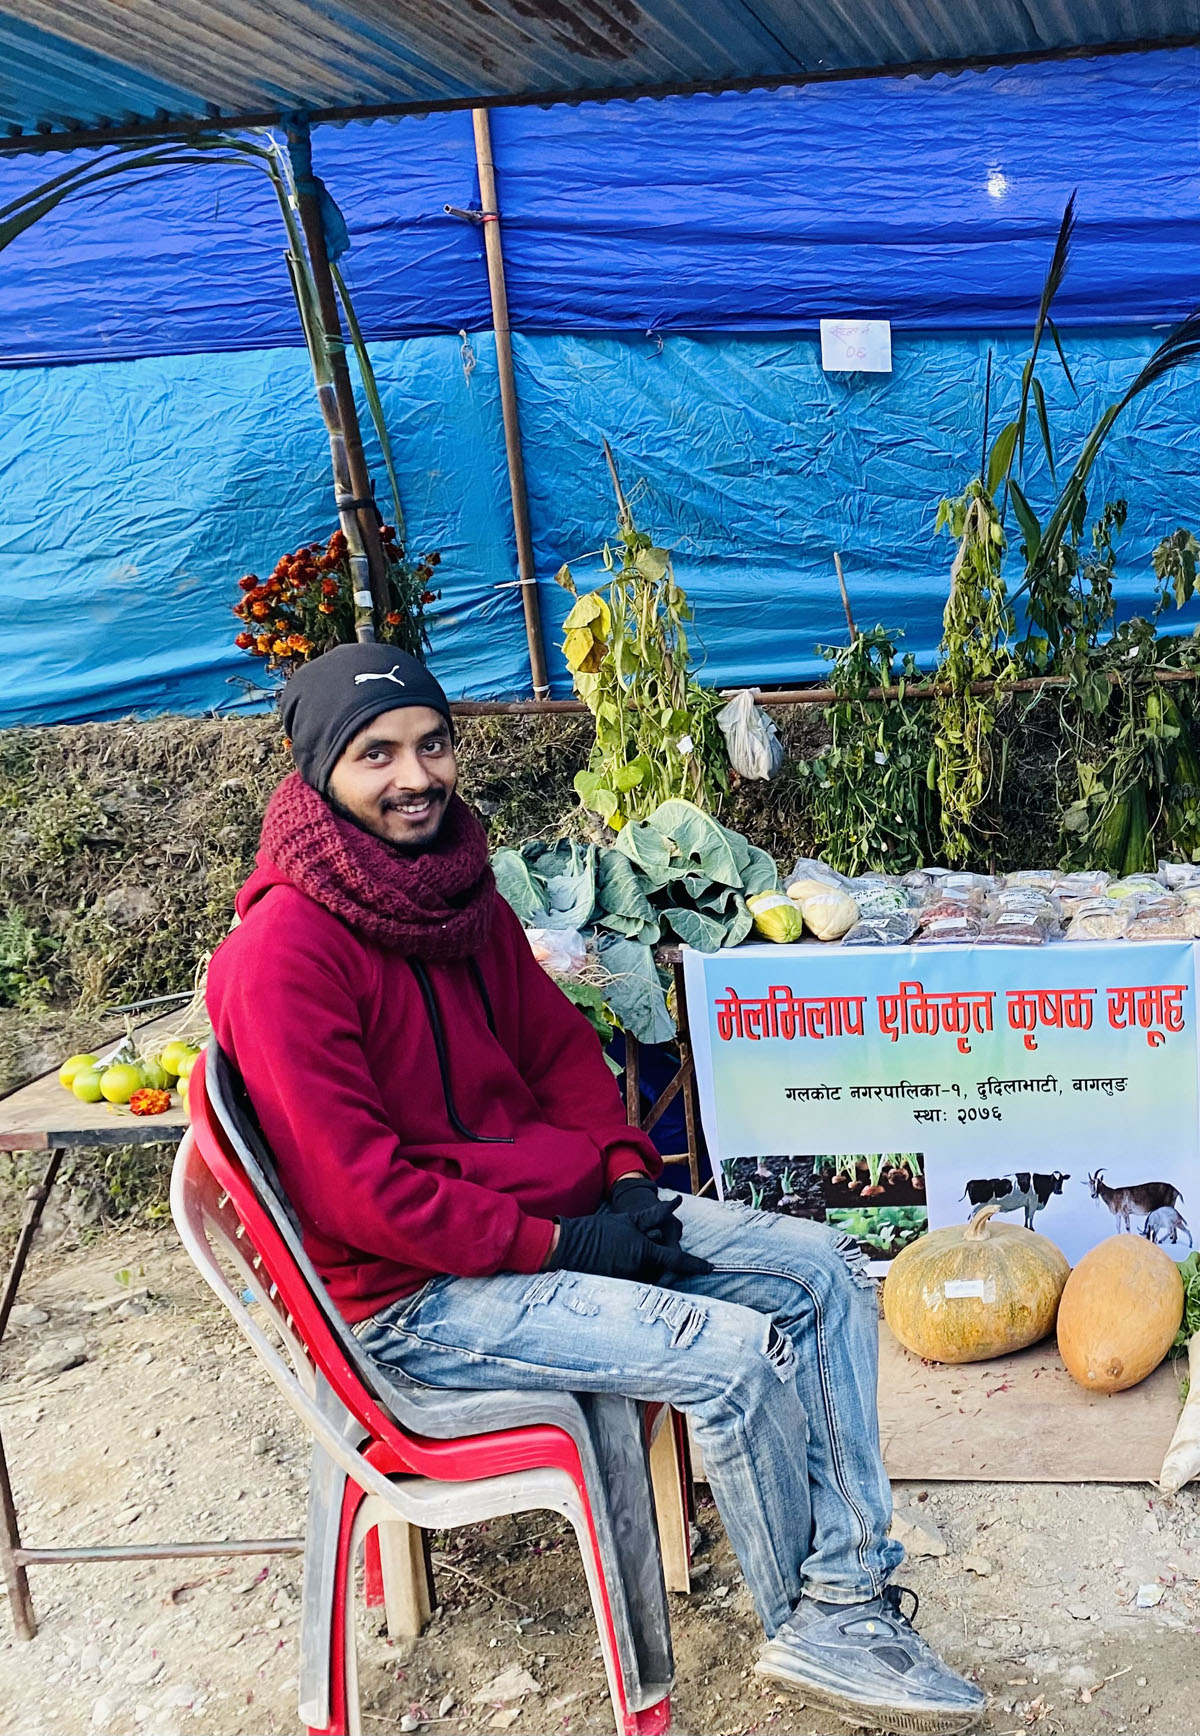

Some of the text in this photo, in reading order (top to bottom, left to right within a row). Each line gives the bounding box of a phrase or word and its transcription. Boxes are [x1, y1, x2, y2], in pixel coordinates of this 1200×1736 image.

[715, 981, 1189, 1054] मेलमिलाप एकिकृत कृषक समूह
[784, 1074, 1129, 1102] गलकोट नगरपालिका-१, दुदिलाभाटी, बागलुङ
[957, 1106, 1003, 1125] २०७६
